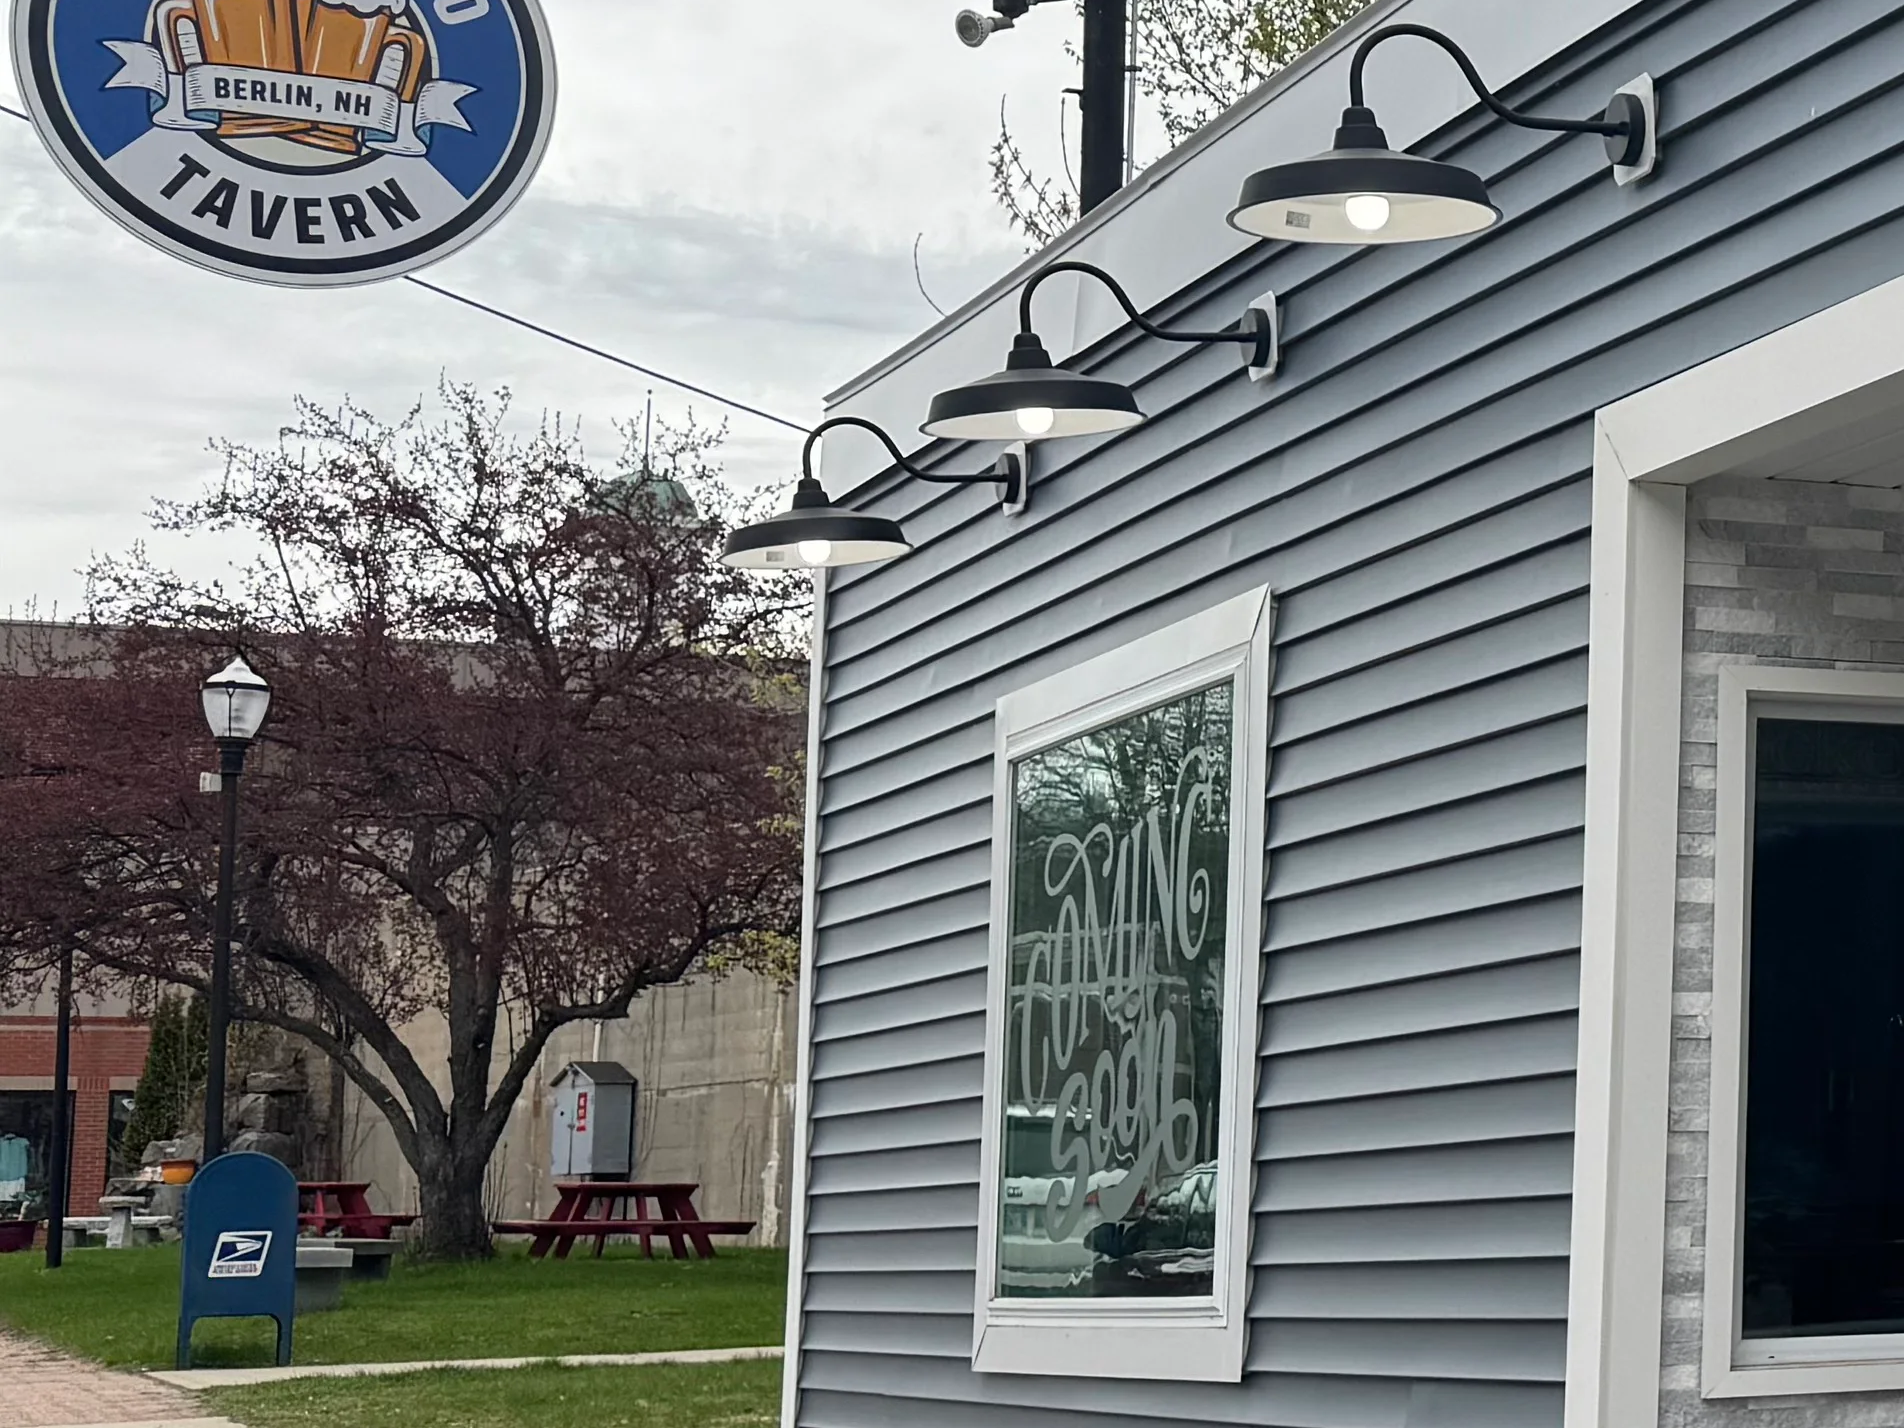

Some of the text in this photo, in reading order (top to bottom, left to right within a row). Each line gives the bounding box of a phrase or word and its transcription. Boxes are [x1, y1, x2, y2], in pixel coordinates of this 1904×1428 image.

[213, 76, 373, 117] BERLIN, NH
[158, 152, 422, 246] TAVERN
